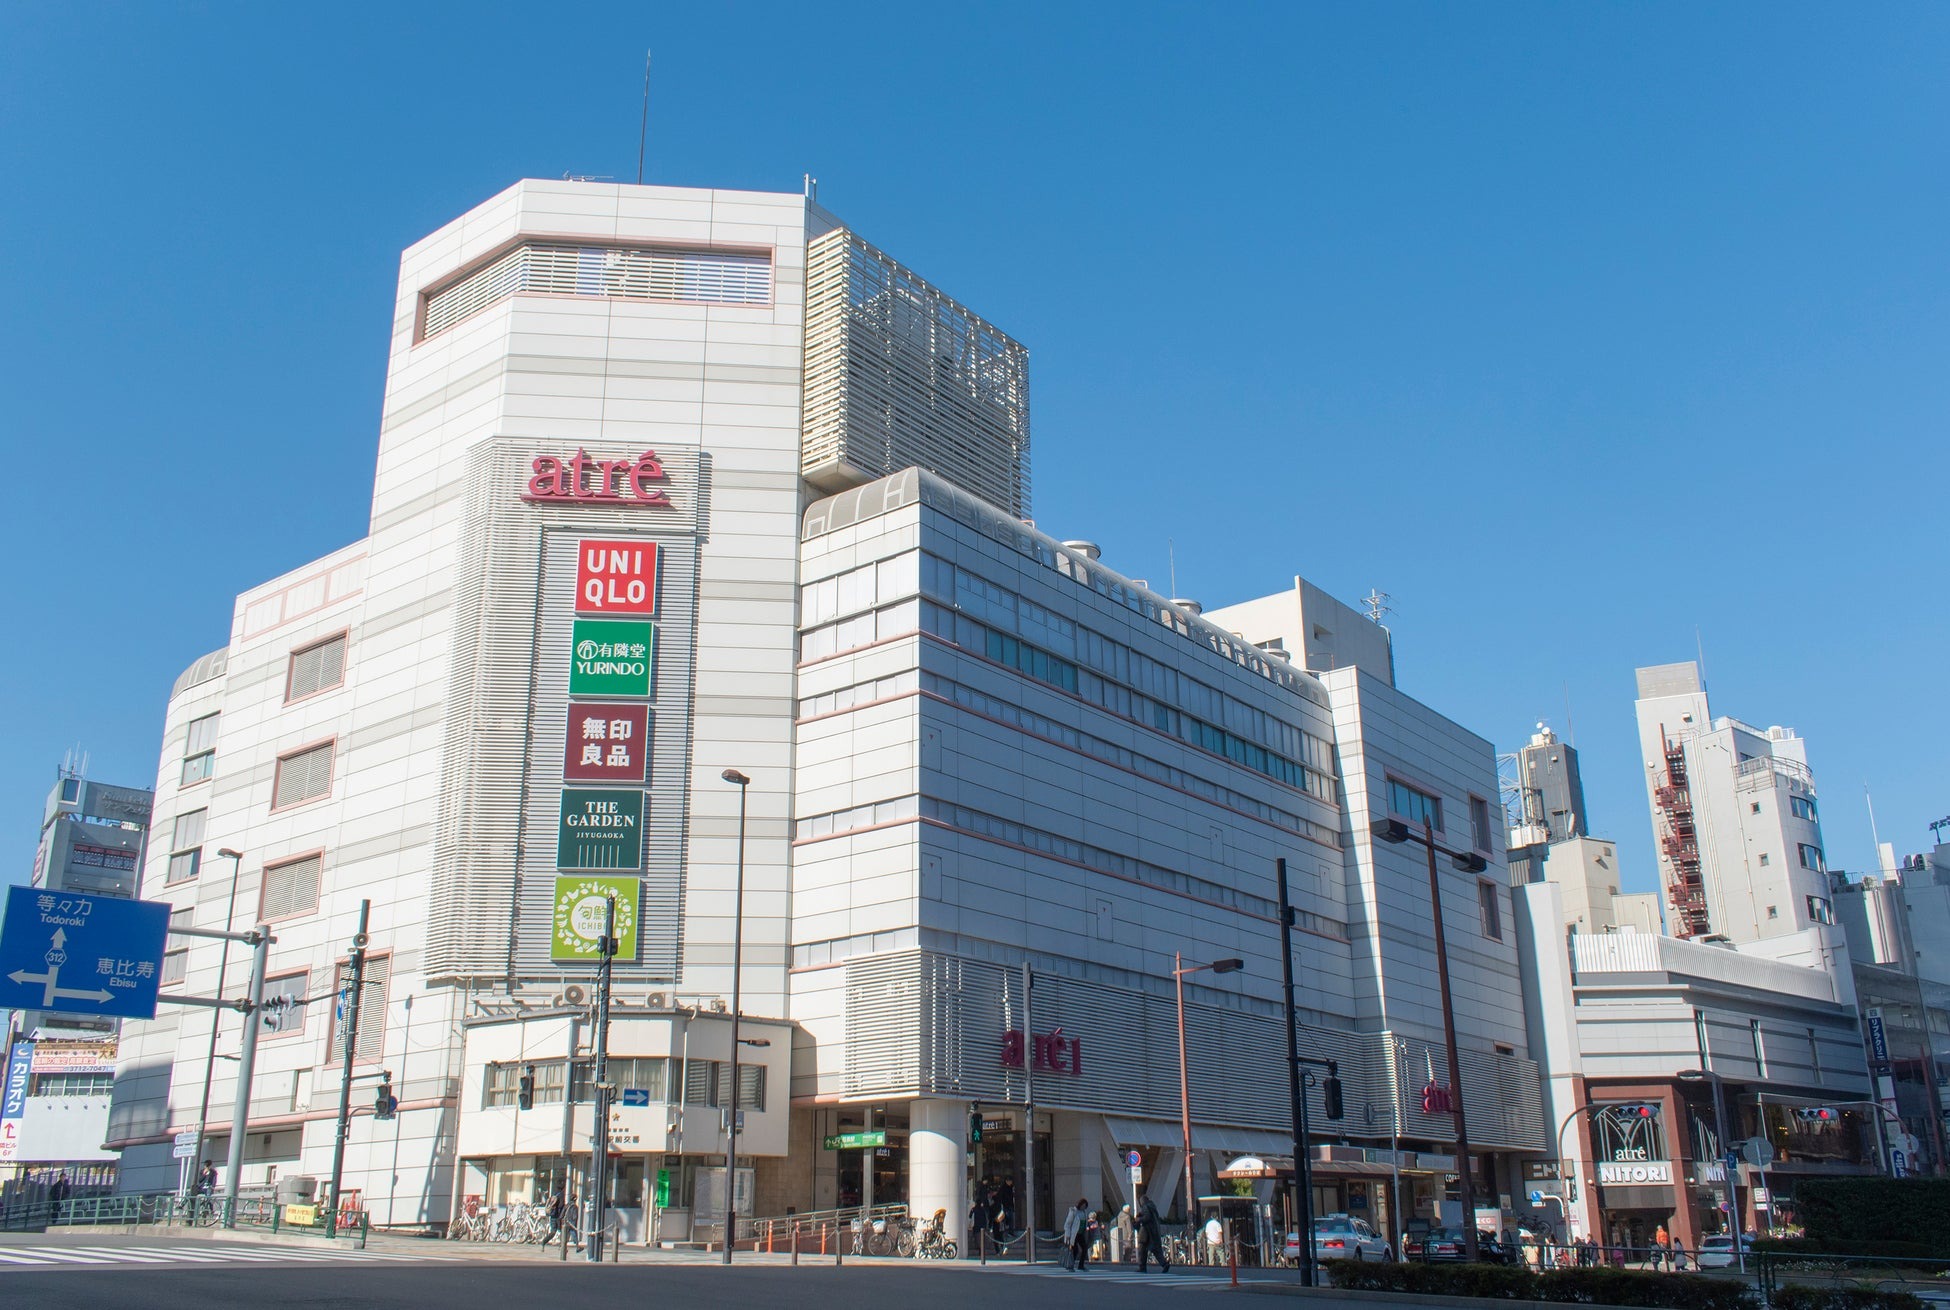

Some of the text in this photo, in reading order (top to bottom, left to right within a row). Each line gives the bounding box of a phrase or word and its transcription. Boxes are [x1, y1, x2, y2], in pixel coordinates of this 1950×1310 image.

[528, 447, 664, 500] atré
[587, 549, 642, 574] UNI
[585, 579, 646, 607] QLO
[598, 643, 646, 658] 有隣堂
[576, 661, 645, 676] YURINDO
[582, 717, 632, 740] 無印
[580, 743, 630, 767] 良品
[585, 801, 619, 814] THE
[566, 814, 635, 827] GARDEN
[36, 894, 92, 916] 等々力
[40, 913, 85, 927] Todoroki
[47, 952, 63, 963] 312
[96, 958, 155, 979] 恵比寿
[109, 977, 137, 988] Ebisu
[8, 1062, 28, 1113] カラオケ
[1615, 1146, 1647, 1160] atré
[1600, 1166, 1668, 1182] NITORI
[1705, 1166, 1725, 1181] NIT
